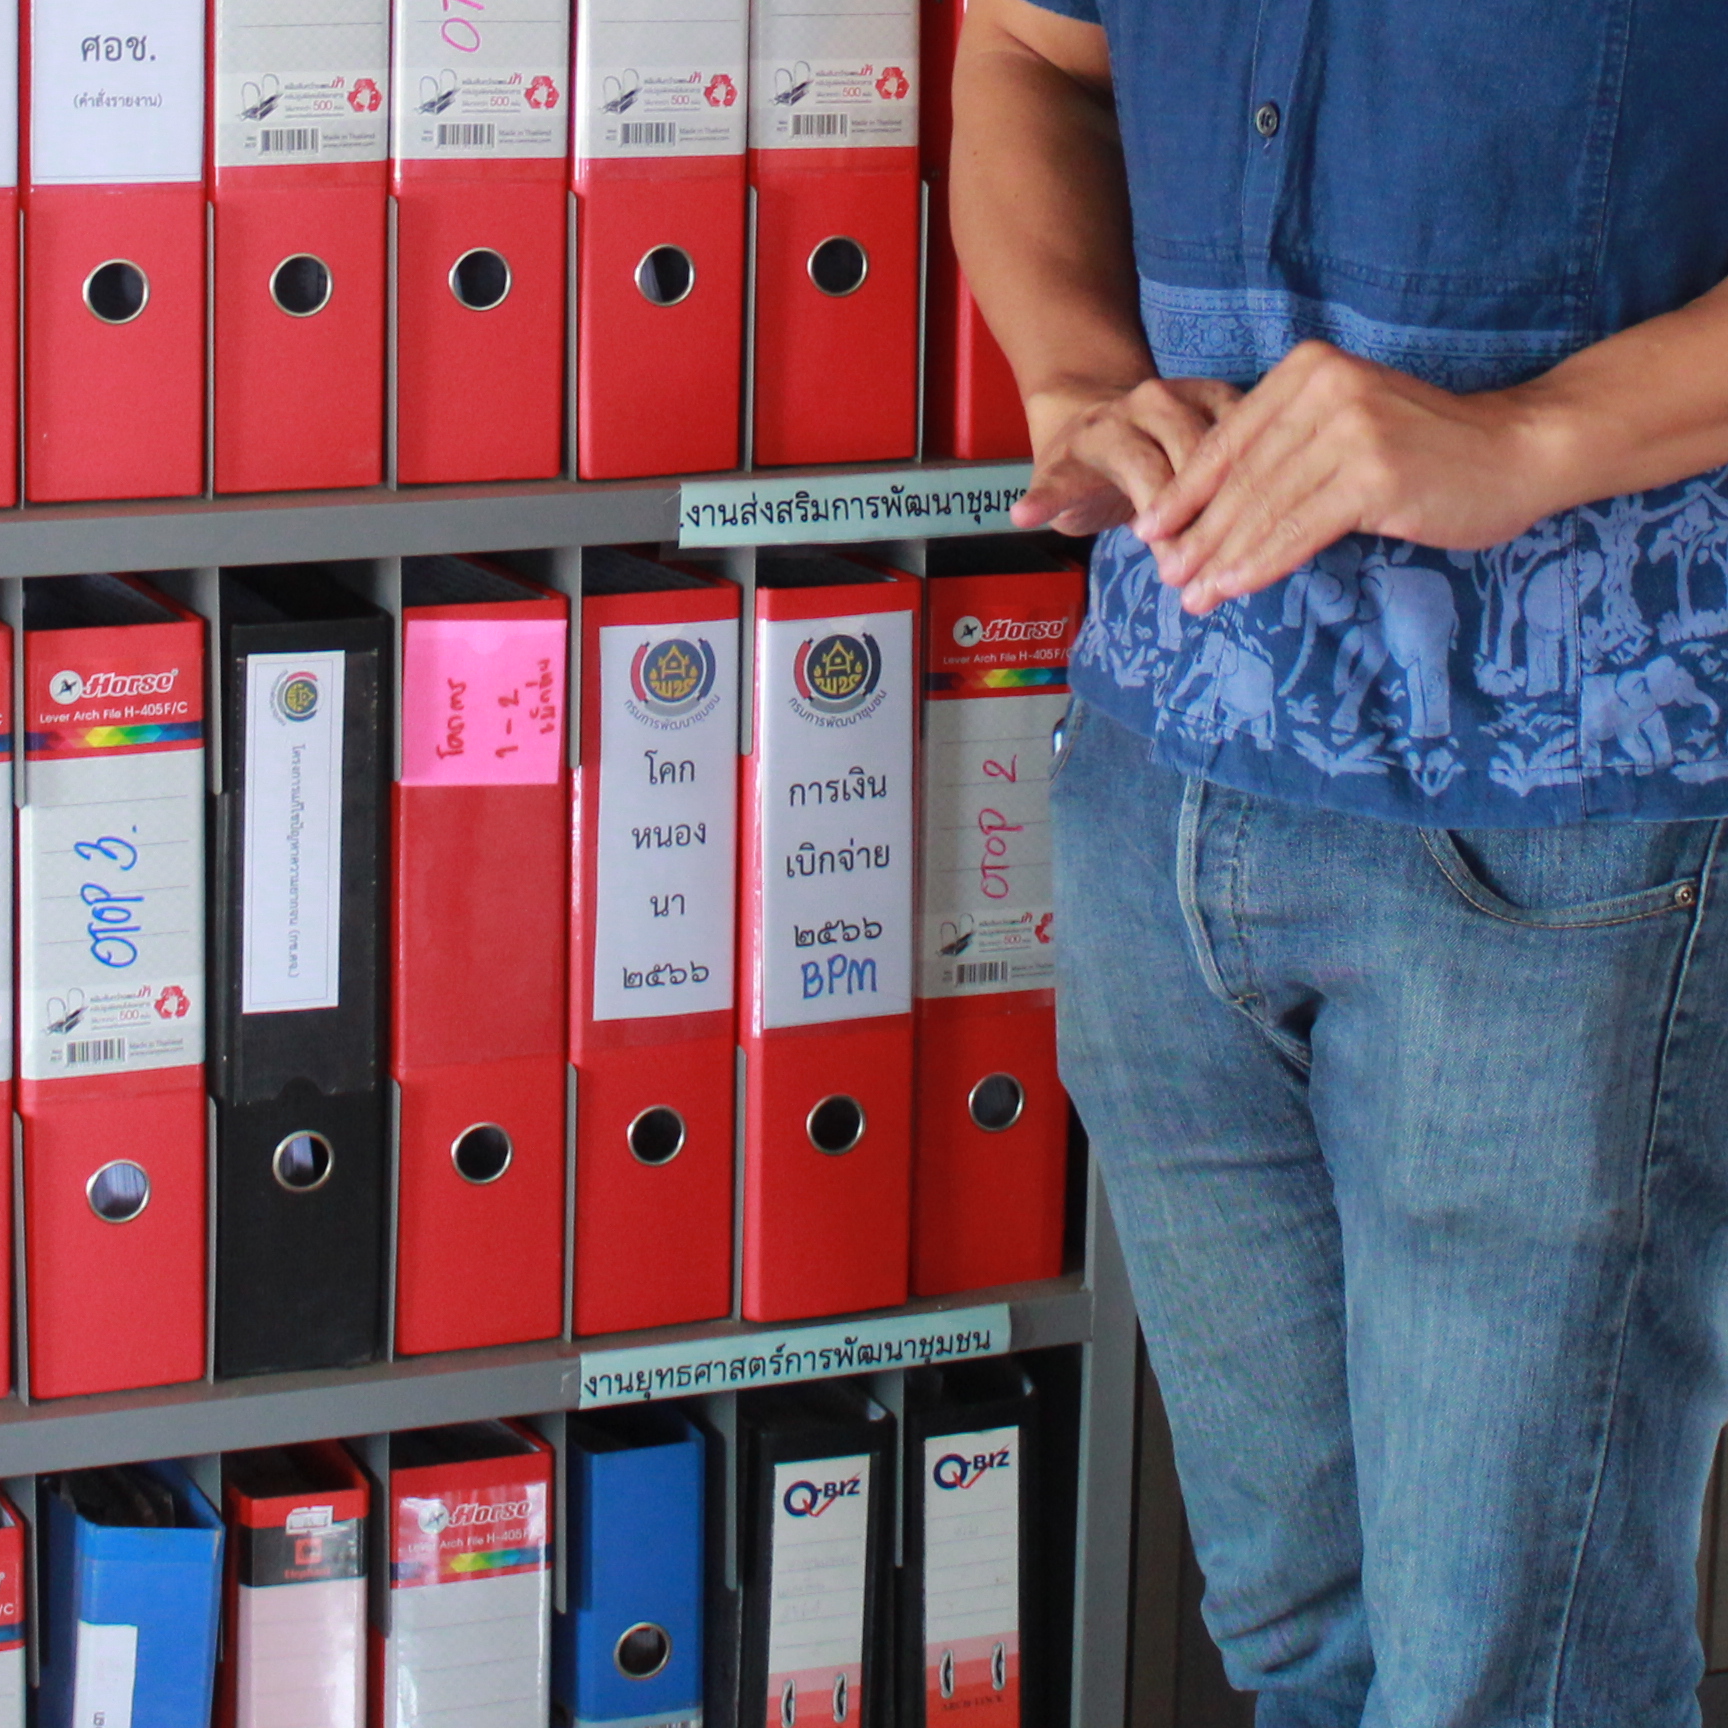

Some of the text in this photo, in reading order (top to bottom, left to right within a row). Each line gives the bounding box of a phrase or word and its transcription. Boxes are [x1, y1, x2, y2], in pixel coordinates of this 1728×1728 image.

[80, 35, 157, 62] ศอช.
[73, 92, 163, 109] (คำสั่งรายงาน)
[313, 100, 332, 111] 500
[490, 96, 510, 106] 500
[680, 485, 1030, 528] .งานส่งสริมการพัฒนาชุมช
[980, 618, 1063, 641] Horse
[943, 655, 971, 665] Lever
[974, 653, 998, 663] Arch
[1000, 652, 1016, 663] File
[81, 670, 172, 699] Horse
[39, 701, 188, 725] Lever Arch File H-405F/C
[623, 692, 720, 732] กรมการพัฒนาชุมชน
[788, 688, 888, 729] กรมการพัฒนาชุมชน
[644, 751, 696, 786] โคก
[789, 766, 887, 807] การเงิน
[631, 820, 707, 850] หนอง
[786, 838, 890, 878] เบิกจ่าย
[978, 807, 1024, 900] OTOP
[650, 891, 686, 917] นา
[79, 881, 145, 969] OTOP
[793, 917, 883, 948] ๒๕๖๖
[622, 960, 710, 990] ๒๕๖๖
[801, 954, 877, 999] BPM
[584, 1325, 992, 1403] งานยุทธศาสตร์การพัฒนาชุมชน
[448, 1501, 533, 1527] Horse
[440, 1539, 463, 1549] Arch
